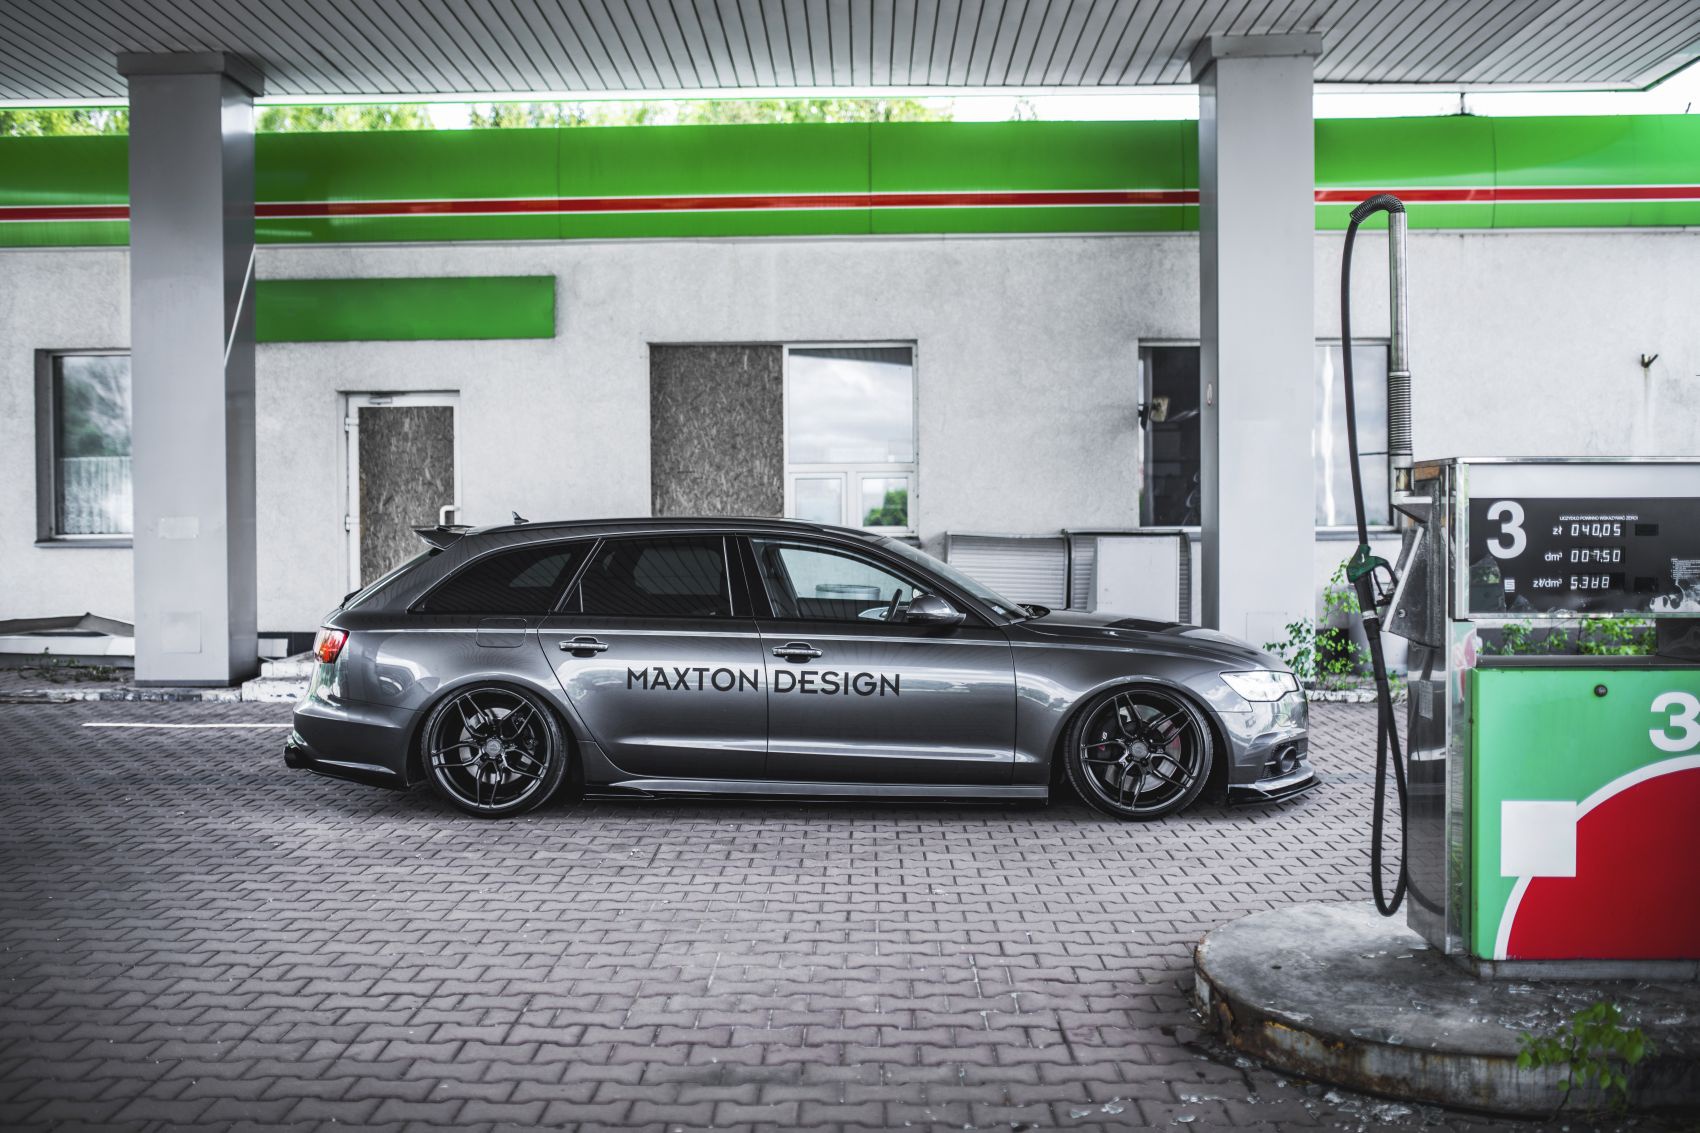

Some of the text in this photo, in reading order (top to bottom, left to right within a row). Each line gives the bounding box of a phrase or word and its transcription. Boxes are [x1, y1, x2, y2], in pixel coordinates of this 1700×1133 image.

[1487, 500, 1527, 559] 3
[1552, 525, 1562, 535] zł
[627, 667, 900, 696] MAXTON DESIGN
[1649, 691, 1700, 751] 3
